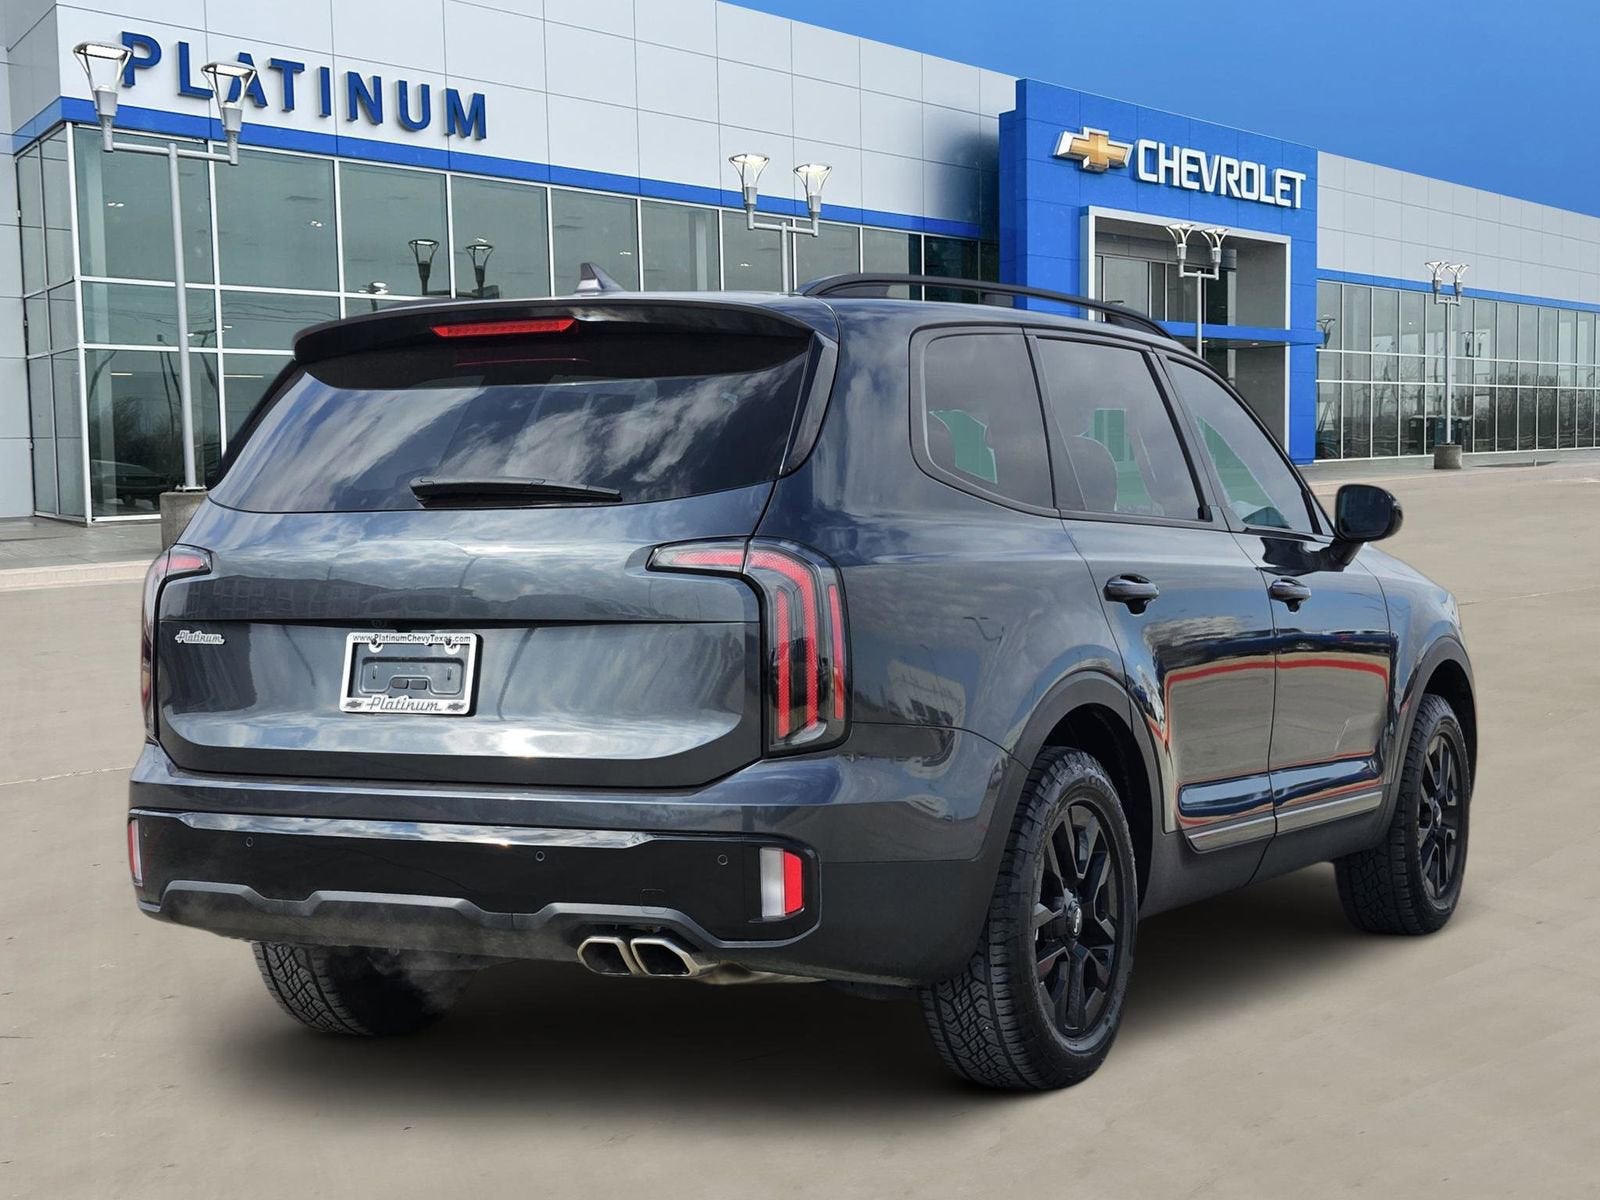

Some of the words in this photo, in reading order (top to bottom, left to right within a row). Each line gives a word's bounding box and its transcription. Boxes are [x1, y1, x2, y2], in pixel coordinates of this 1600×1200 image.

[121, 31, 487, 140] PLATINUM
[1136, 139, 1307, 209] CHEVROLET
[175, 630, 225, 645] Platinum
[366, 696, 442, 711] Platinum
